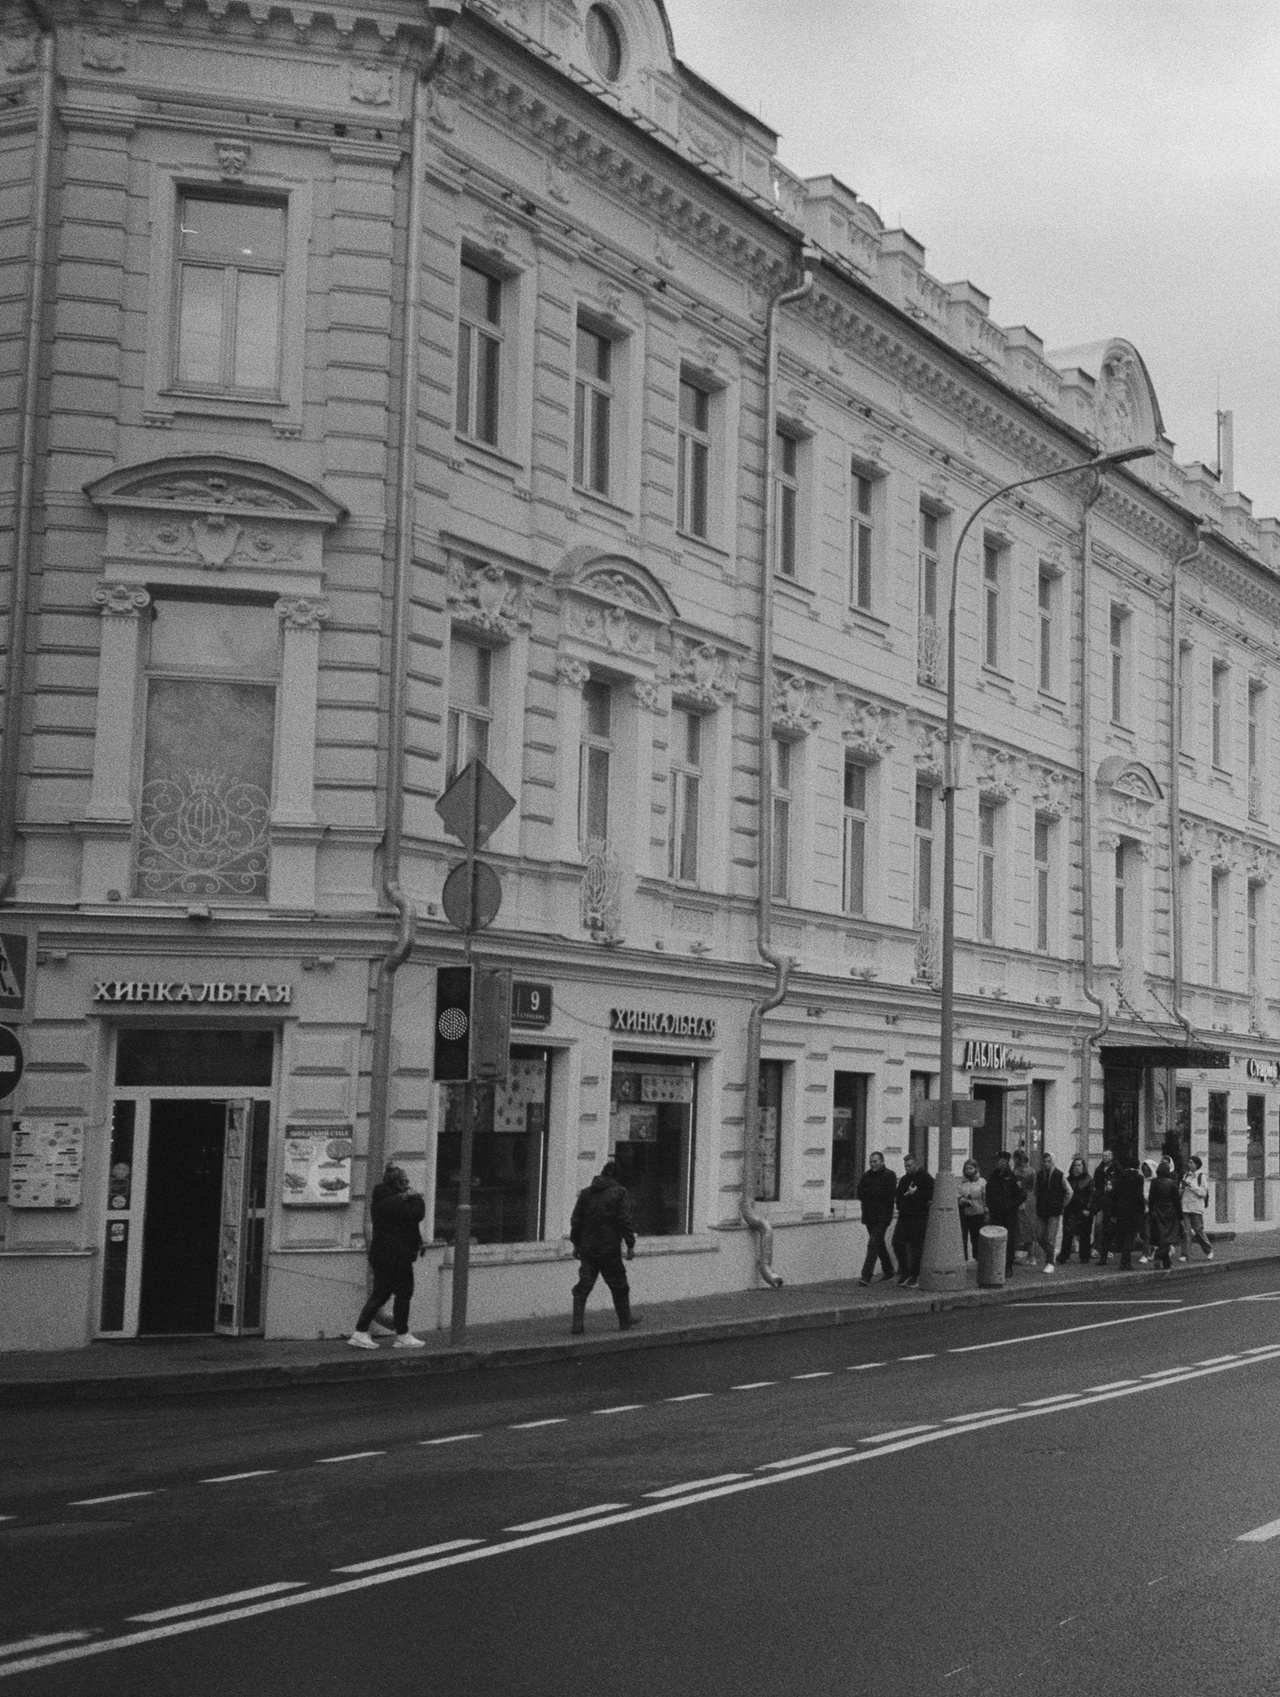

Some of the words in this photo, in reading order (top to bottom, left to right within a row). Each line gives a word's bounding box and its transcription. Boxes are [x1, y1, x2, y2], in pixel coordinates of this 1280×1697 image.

[93, 981, 291, 1003] ХИНКАЛЬНАЯ
[531, 991, 540, 1010] 9
[614, 1009, 715, 1037] ХИНКАЛЬНАЯ
[966, 1041, 1006, 1070] ДАБЛБИ
